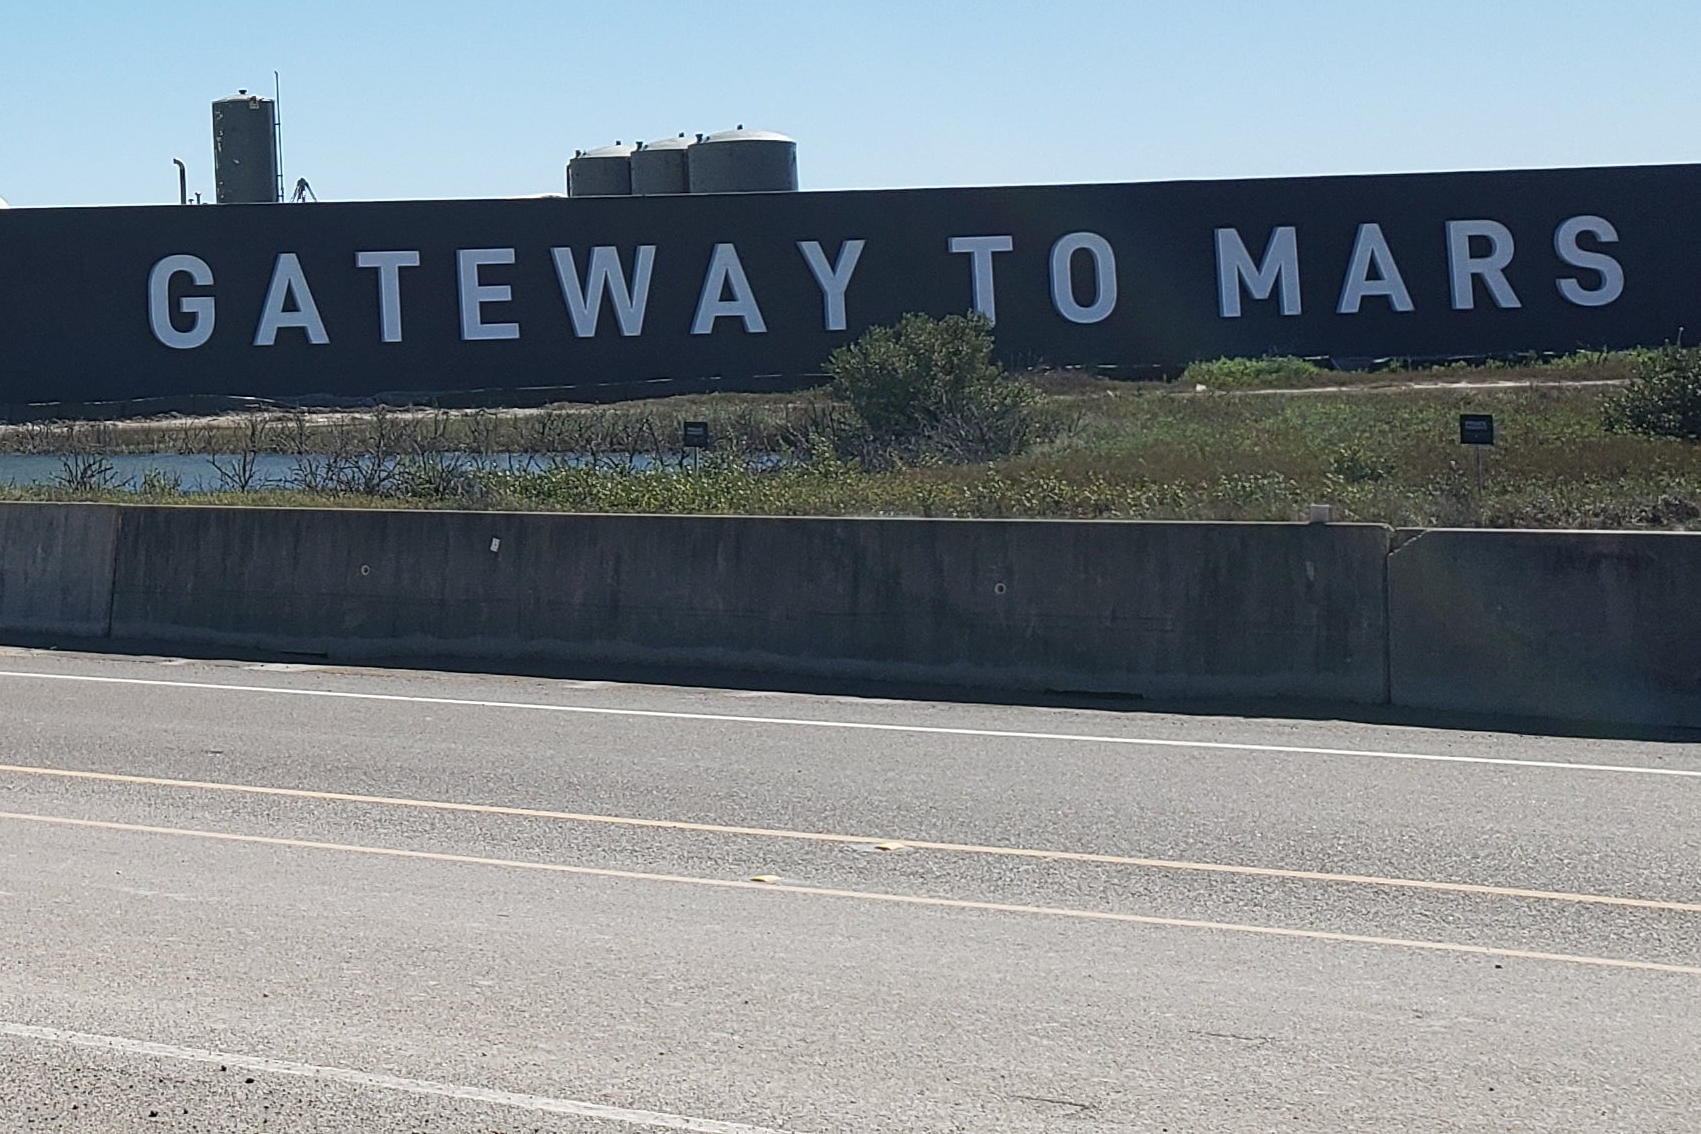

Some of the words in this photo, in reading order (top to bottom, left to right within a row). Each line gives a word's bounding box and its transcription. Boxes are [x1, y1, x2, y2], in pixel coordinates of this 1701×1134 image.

[148, 239, 865, 349] GATEWAY
[949, 232, 1117, 327] TO
[1215, 215, 1625, 318] MARS
